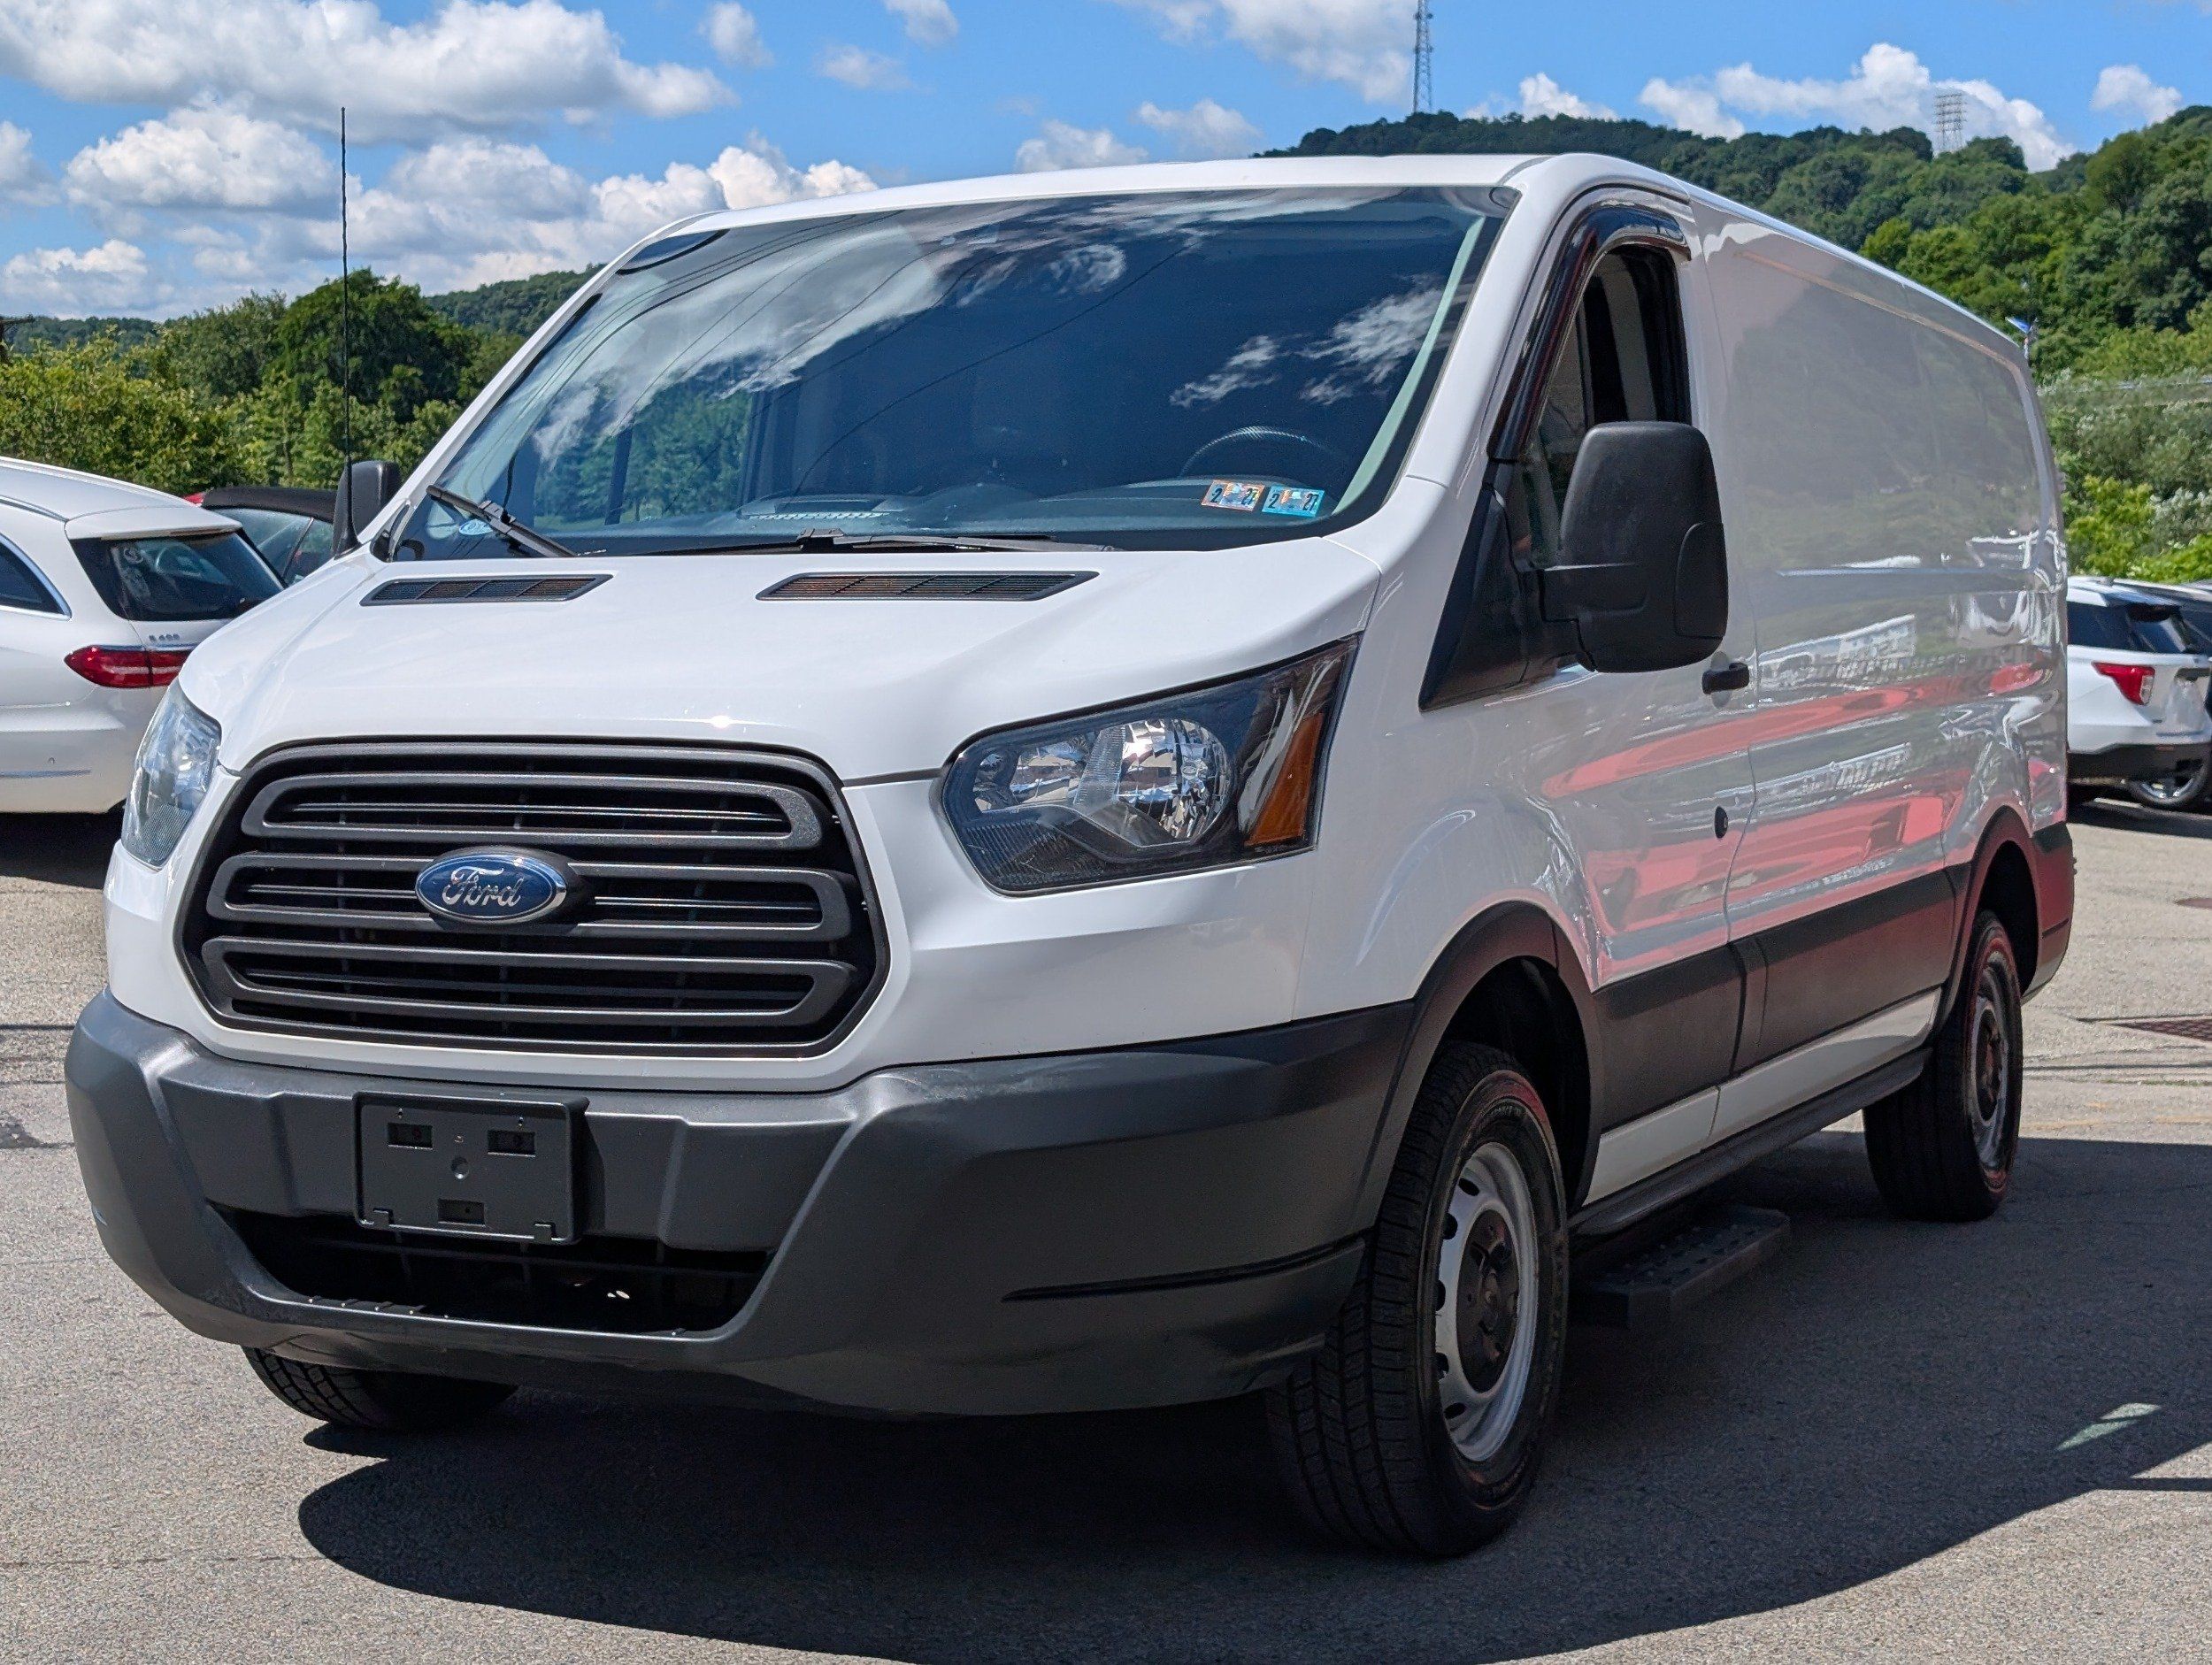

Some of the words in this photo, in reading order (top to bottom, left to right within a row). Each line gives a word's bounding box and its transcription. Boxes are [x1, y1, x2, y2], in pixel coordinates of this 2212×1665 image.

[1210, 487, 1223, 503] 2
[1268, 493, 1280, 509] 2
[1302, 493, 1319, 511] 27
[442, 865, 525, 908] Ford
